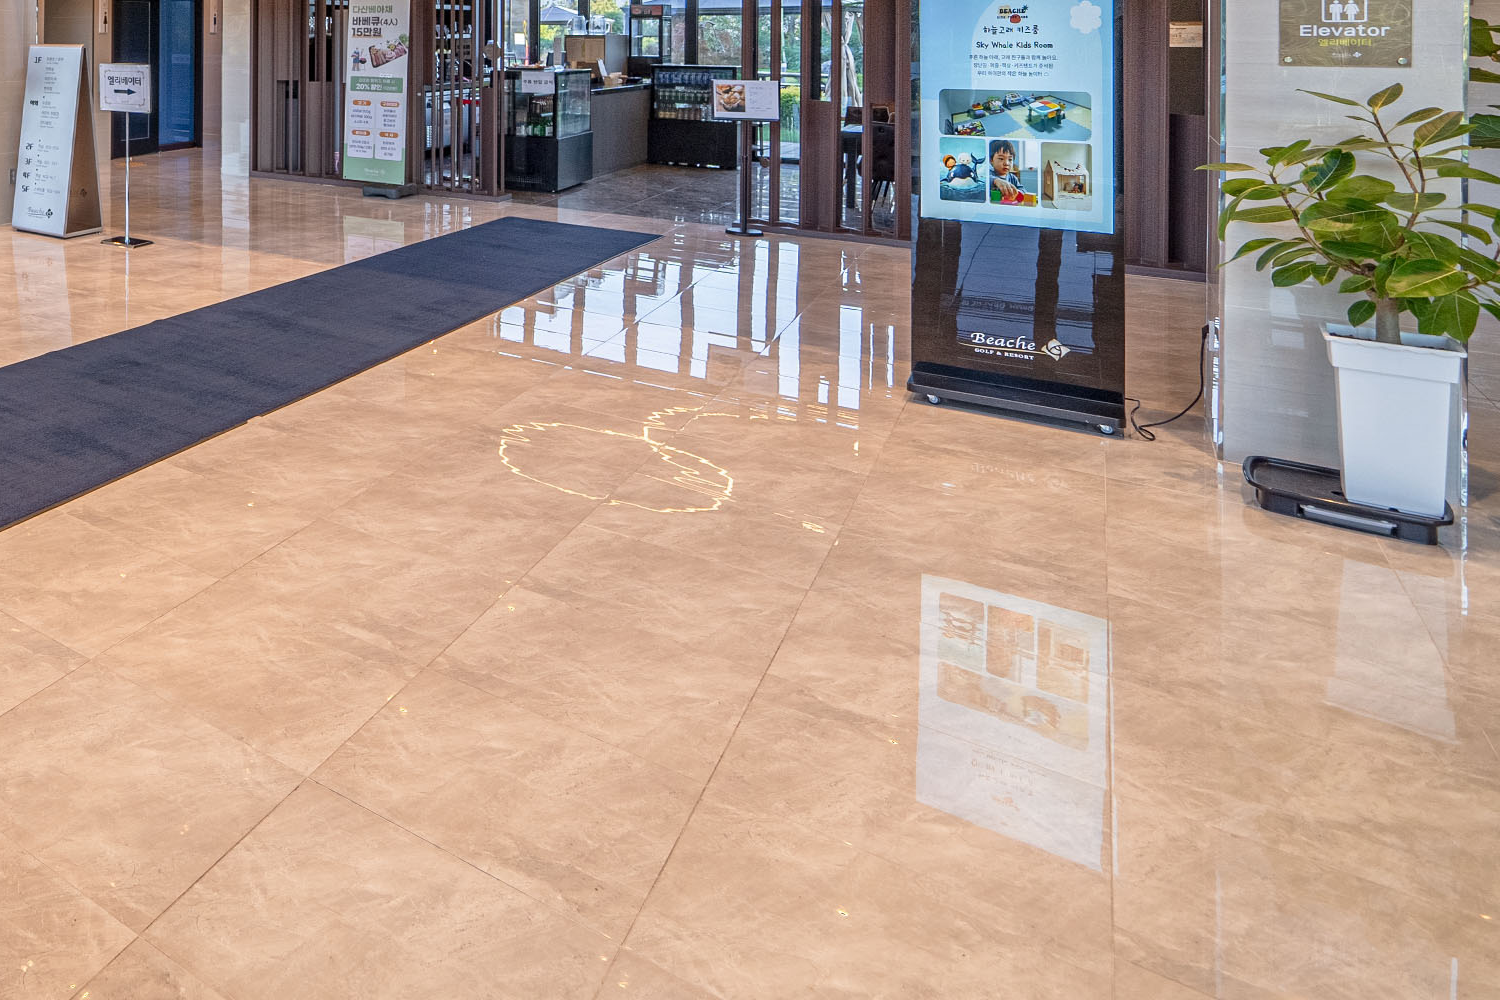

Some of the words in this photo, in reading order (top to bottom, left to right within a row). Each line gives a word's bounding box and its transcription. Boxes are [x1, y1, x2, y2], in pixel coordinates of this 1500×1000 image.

[351, 27, 382, 37] 15만원
[983, 25, 1013, 35] 하늘고래
[1299, 24, 1391, 37] Elevator
[976, 41, 989, 49] Sky
[1318, 38, 1372, 47] 엘리베이터
[107, 75, 142, 86] 엘리베이터
[21, 184, 30, 192] 5F
[970, 332, 1036, 350] Beache
[974, 347, 994, 355] GOLF
[1004, 351, 1035, 360] RESORT
